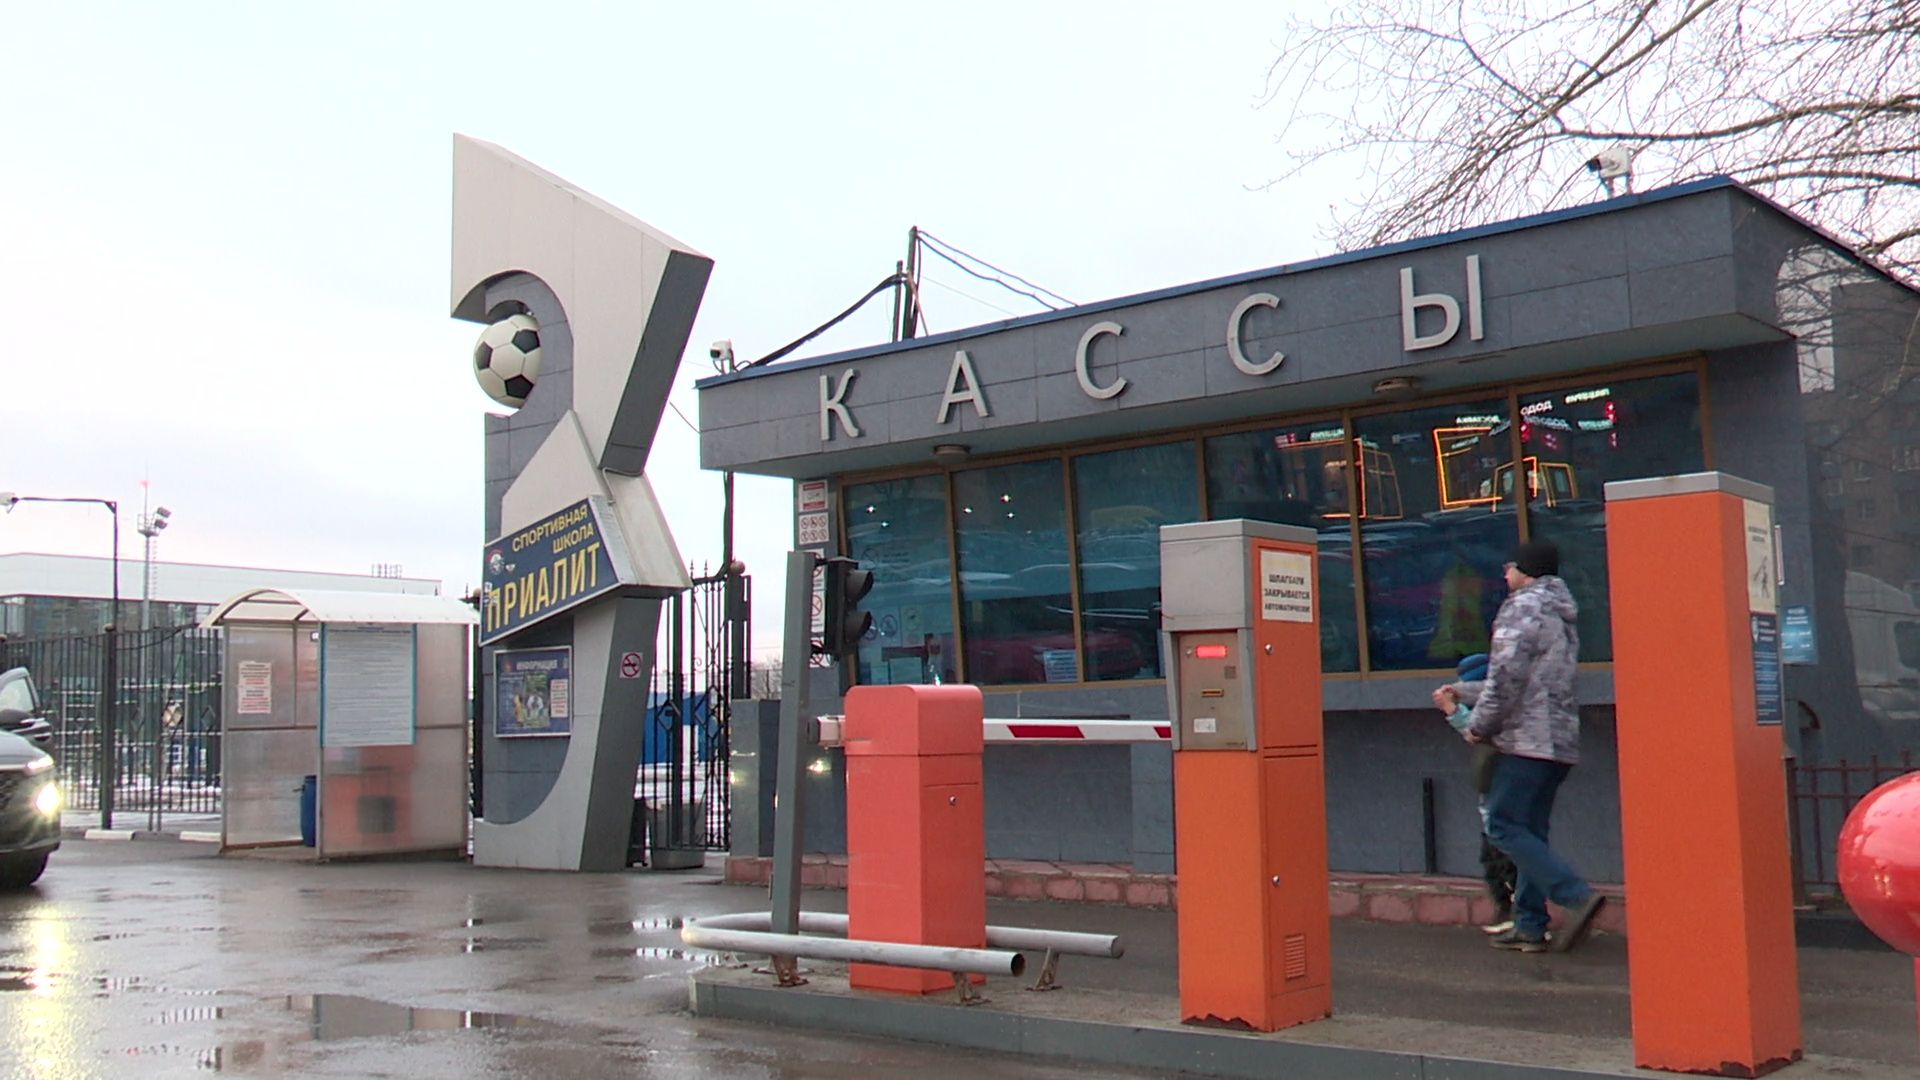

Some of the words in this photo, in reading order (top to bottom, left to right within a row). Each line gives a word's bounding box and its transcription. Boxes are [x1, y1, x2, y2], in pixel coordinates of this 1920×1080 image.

[820, 254, 1484, 441] КАССЫ
[512, 504, 588, 552] СПОРТИВНАЯ
[553, 523, 594, 554] ШКОЛА
[1264, 588, 1309, 599] ЗАКРЫВАЕТСЯ
